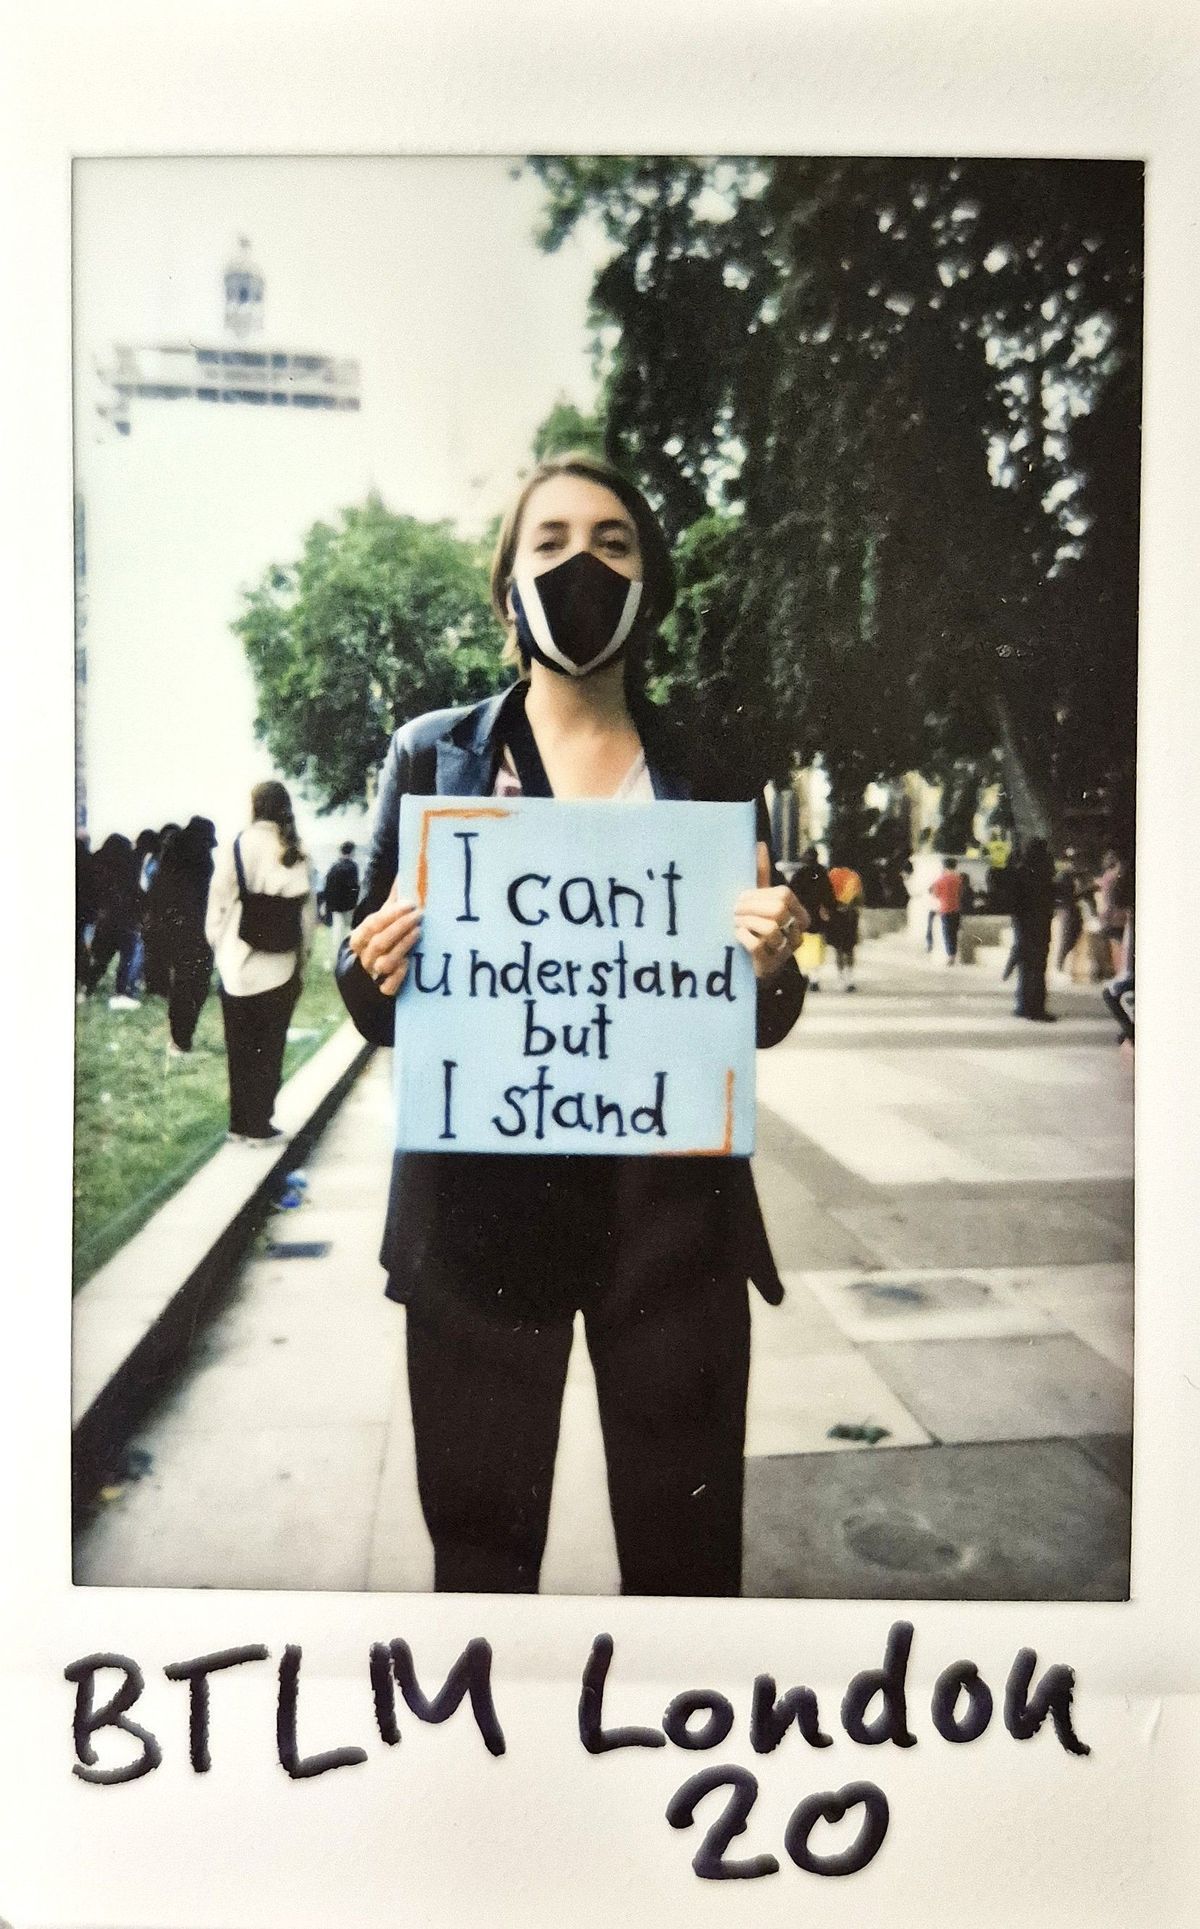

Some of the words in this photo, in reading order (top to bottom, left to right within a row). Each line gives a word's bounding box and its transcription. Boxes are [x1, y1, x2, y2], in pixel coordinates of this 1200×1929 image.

[453, 832, 480, 922] I
[507, 861, 683, 936] can't
[412, 941, 737, 1002] understand
[523, 999, 613, 1060] but
[439, 1060, 458, 1139] I
[491, 1065, 667, 1140] stand
[64, 1635, 507, 1786] BTLM
[577, 1619, 1093, 1756] London
[665, 1764, 890, 1881] 20
